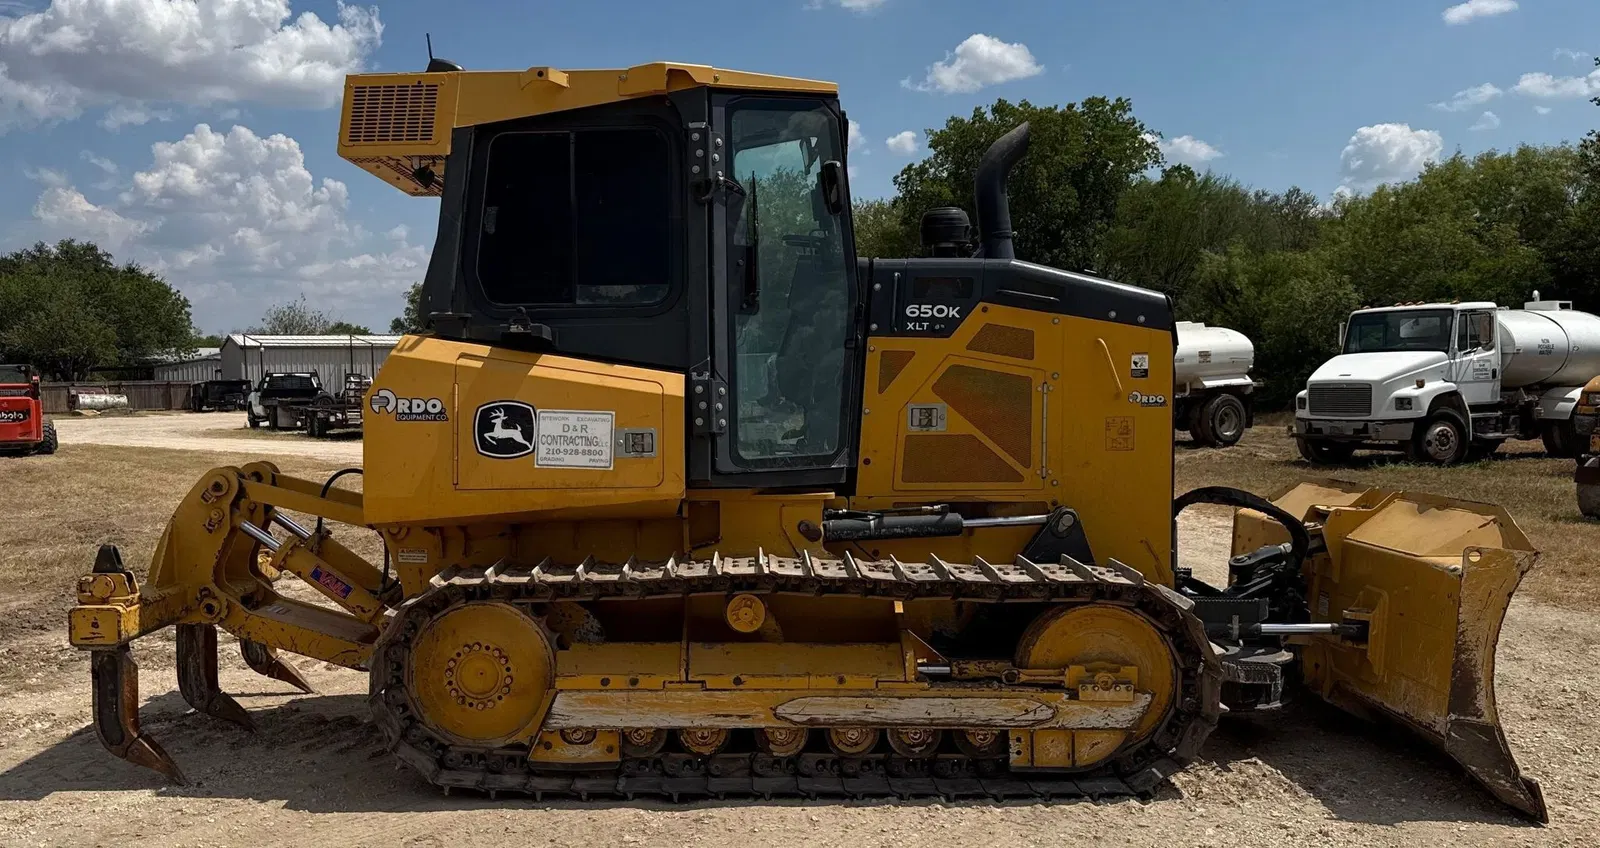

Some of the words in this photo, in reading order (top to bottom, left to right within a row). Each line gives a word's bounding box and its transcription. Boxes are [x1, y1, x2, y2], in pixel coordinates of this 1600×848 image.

[905, 304, 961, 318] 650K
[906, 322, 930, 331] XLT
[1141, 395, 1165, 403] RDO
[396, 399, 442, 413] RDO
[562, 424, 570, 433] D
[580, 424, 588, 433] R
[540, 434, 598, 447] CONTRACTING
